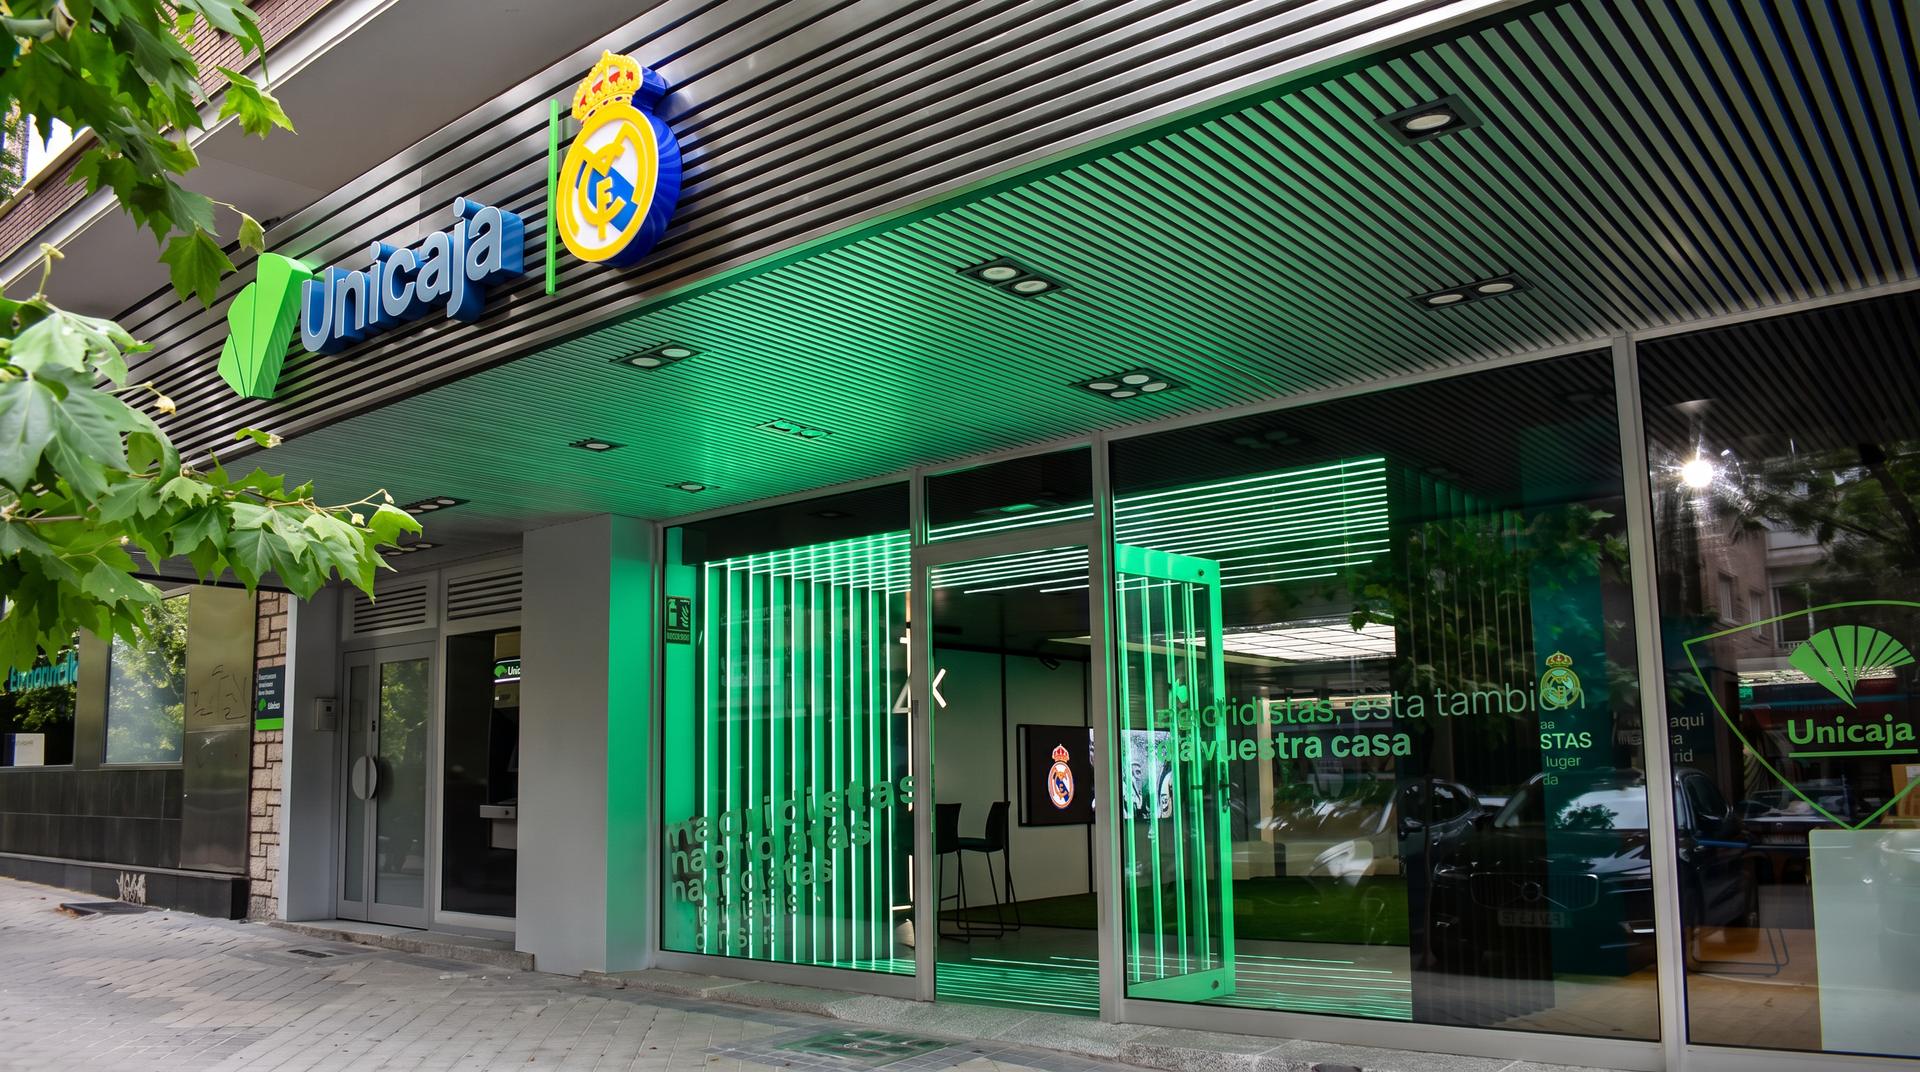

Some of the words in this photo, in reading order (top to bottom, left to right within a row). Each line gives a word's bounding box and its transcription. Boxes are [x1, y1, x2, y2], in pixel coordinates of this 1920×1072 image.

[301, 197, 503, 352] Unicaja
[1351, 691, 1424, 721] esta
[1331, 732, 1412, 758] casa
[1540, 732, 1593, 750] STAS
[1788, 714, 1916, 749] Unicaja
